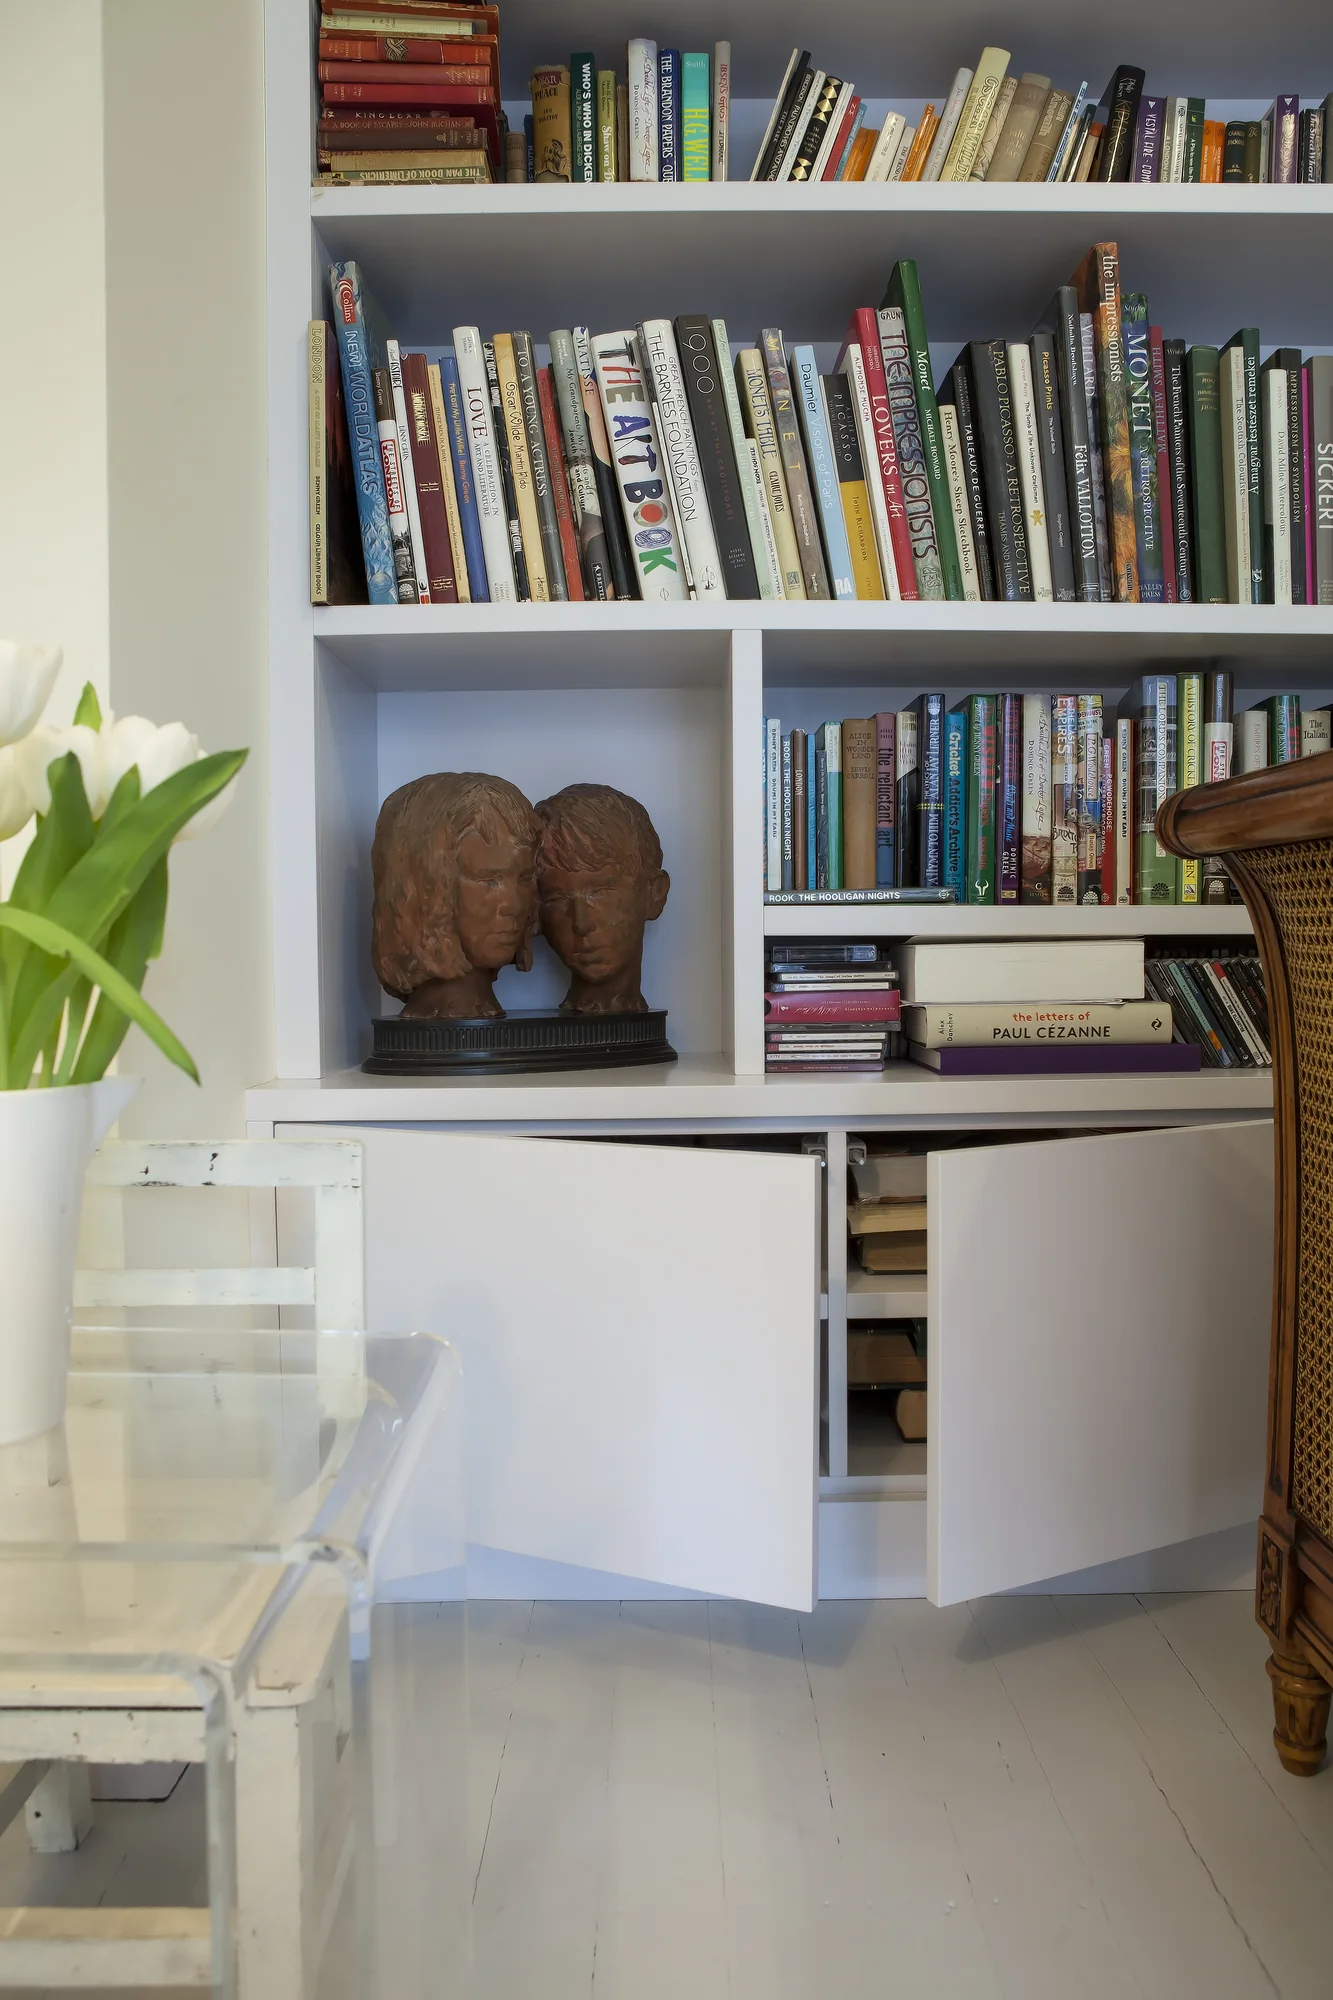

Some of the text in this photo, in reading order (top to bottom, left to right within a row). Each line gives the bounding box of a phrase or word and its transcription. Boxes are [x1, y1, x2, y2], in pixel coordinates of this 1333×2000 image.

[661, 54, 672, 74] THE
[582, 63, 591, 100] WHO'S
[661, 76, 673, 121] BRANDON
[583, 101, 592, 128] WHO
[684, 108, 709, 136] H.G.
[773, 110, 788, 143] THE PARK
[951, 76, 999, 182] OSCAR WILDE
[1309, 113, 1317, 128] The
[583, 130, 592, 141] IN
[602, 126, 612, 166] Shaw on
[662, 124, 673, 158] PAPERS
[1142, 113, 1157, 157] VESTAL FIRE
[359, 170, 405, 180] LIMERICKS
[406, 170, 416, 179] OF
[445, 169, 462, 177] PAN
[464, 168, 480, 176] THE
[1307, 151, 1315, 175] Where
[341, 290, 354, 323] Collins
[1099, 254, 1123, 383] the impressionists
[566, 368, 575, 381] My
[575, 337, 595, 396] MATISSE
[682, 324, 715, 394] 1900
[1080, 322, 1097, 397] VUILLARD
[505, 381, 517, 410] Oscar
[854, 356, 871, 423] ALPHONSE MUCHA
[1152, 346, 1167, 454] MATTHEW SMITH
[508, 411, 522, 441] Wilde
[515, 348, 548, 497] TO A YOUNG ACTRESS
[648, 332, 698, 522] THE BARNES FOUNDATION
[833, 393, 854, 463] PICASSO
[914, 349, 942, 481] Monet MICHAEL HOWARD
[466, 387, 488, 439] LOVE
[484, 450, 497, 505] CELEBRATION
[492, 507, 499, 516] IN
[568, 428, 578, 454] Jewish
[576, 434, 586, 448] My
[800, 363, 835, 510] Daumier Visions of Paris
[1127, 333, 1154, 551] MONET A RETROSPECTIVE
[1236, 397, 1247, 496] The Scottish Colourists
[1289, 370, 1301, 524] IMPRESSIONISM TO SYMBOLISM
[513, 445, 526, 470] Martin
[572, 456, 580, 468] Art
[578, 448, 589, 478] Parents
[597, 336, 678, 577] THE ART BOOK
[992, 350, 1031, 595] PABLO PICASSO: A RETROSPECTIVE
[1171, 365, 1188, 578] The French Painters of the Seventeenth Century
[382, 442, 396, 509] LONDON
[388, 443, 401, 509] THE STREETS OF
[583, 476, 591, 488] and
[964, 423, 986, 538] TABLEAUX DE GUERRE
[576, 484, 587, 512] Culture
[943, 411, 973, 576] Henry Moore's Sheep Sketchbook
[1073, 444, 1096, 560] Félix VALLOTTON
[1057, 697, 1070, 755] EMPIRES
[1187, 691, 1196, 732] HISTORY
[1308, 720, 1323, 729] The
[848, 732, 872, 740] ALICE
[1158, 684, 1166, 800] THE LORD'S COMPANION
[1188, 733, 1196, 745] OF
[1303, 730, 1328, 740] Italians
[795, 769, 803, 796] LONDON
[877, 748, 893, 848] the reluctant art
[949, 731, 961, 872] Cricket Addict's Archive
[784, 830, 792, 861] NIGHTS
[1001, 851, 1010, 874] GREEN
[769, 892, 900, 902] ROOK THE HOOLIGAN NIGHTS
[938, 1019, 946, 1035] Alex
[992, 1023, 1111, 1040] PAUL CÉZANNE
[1012, 1011, 1091, 1023] the letters of
